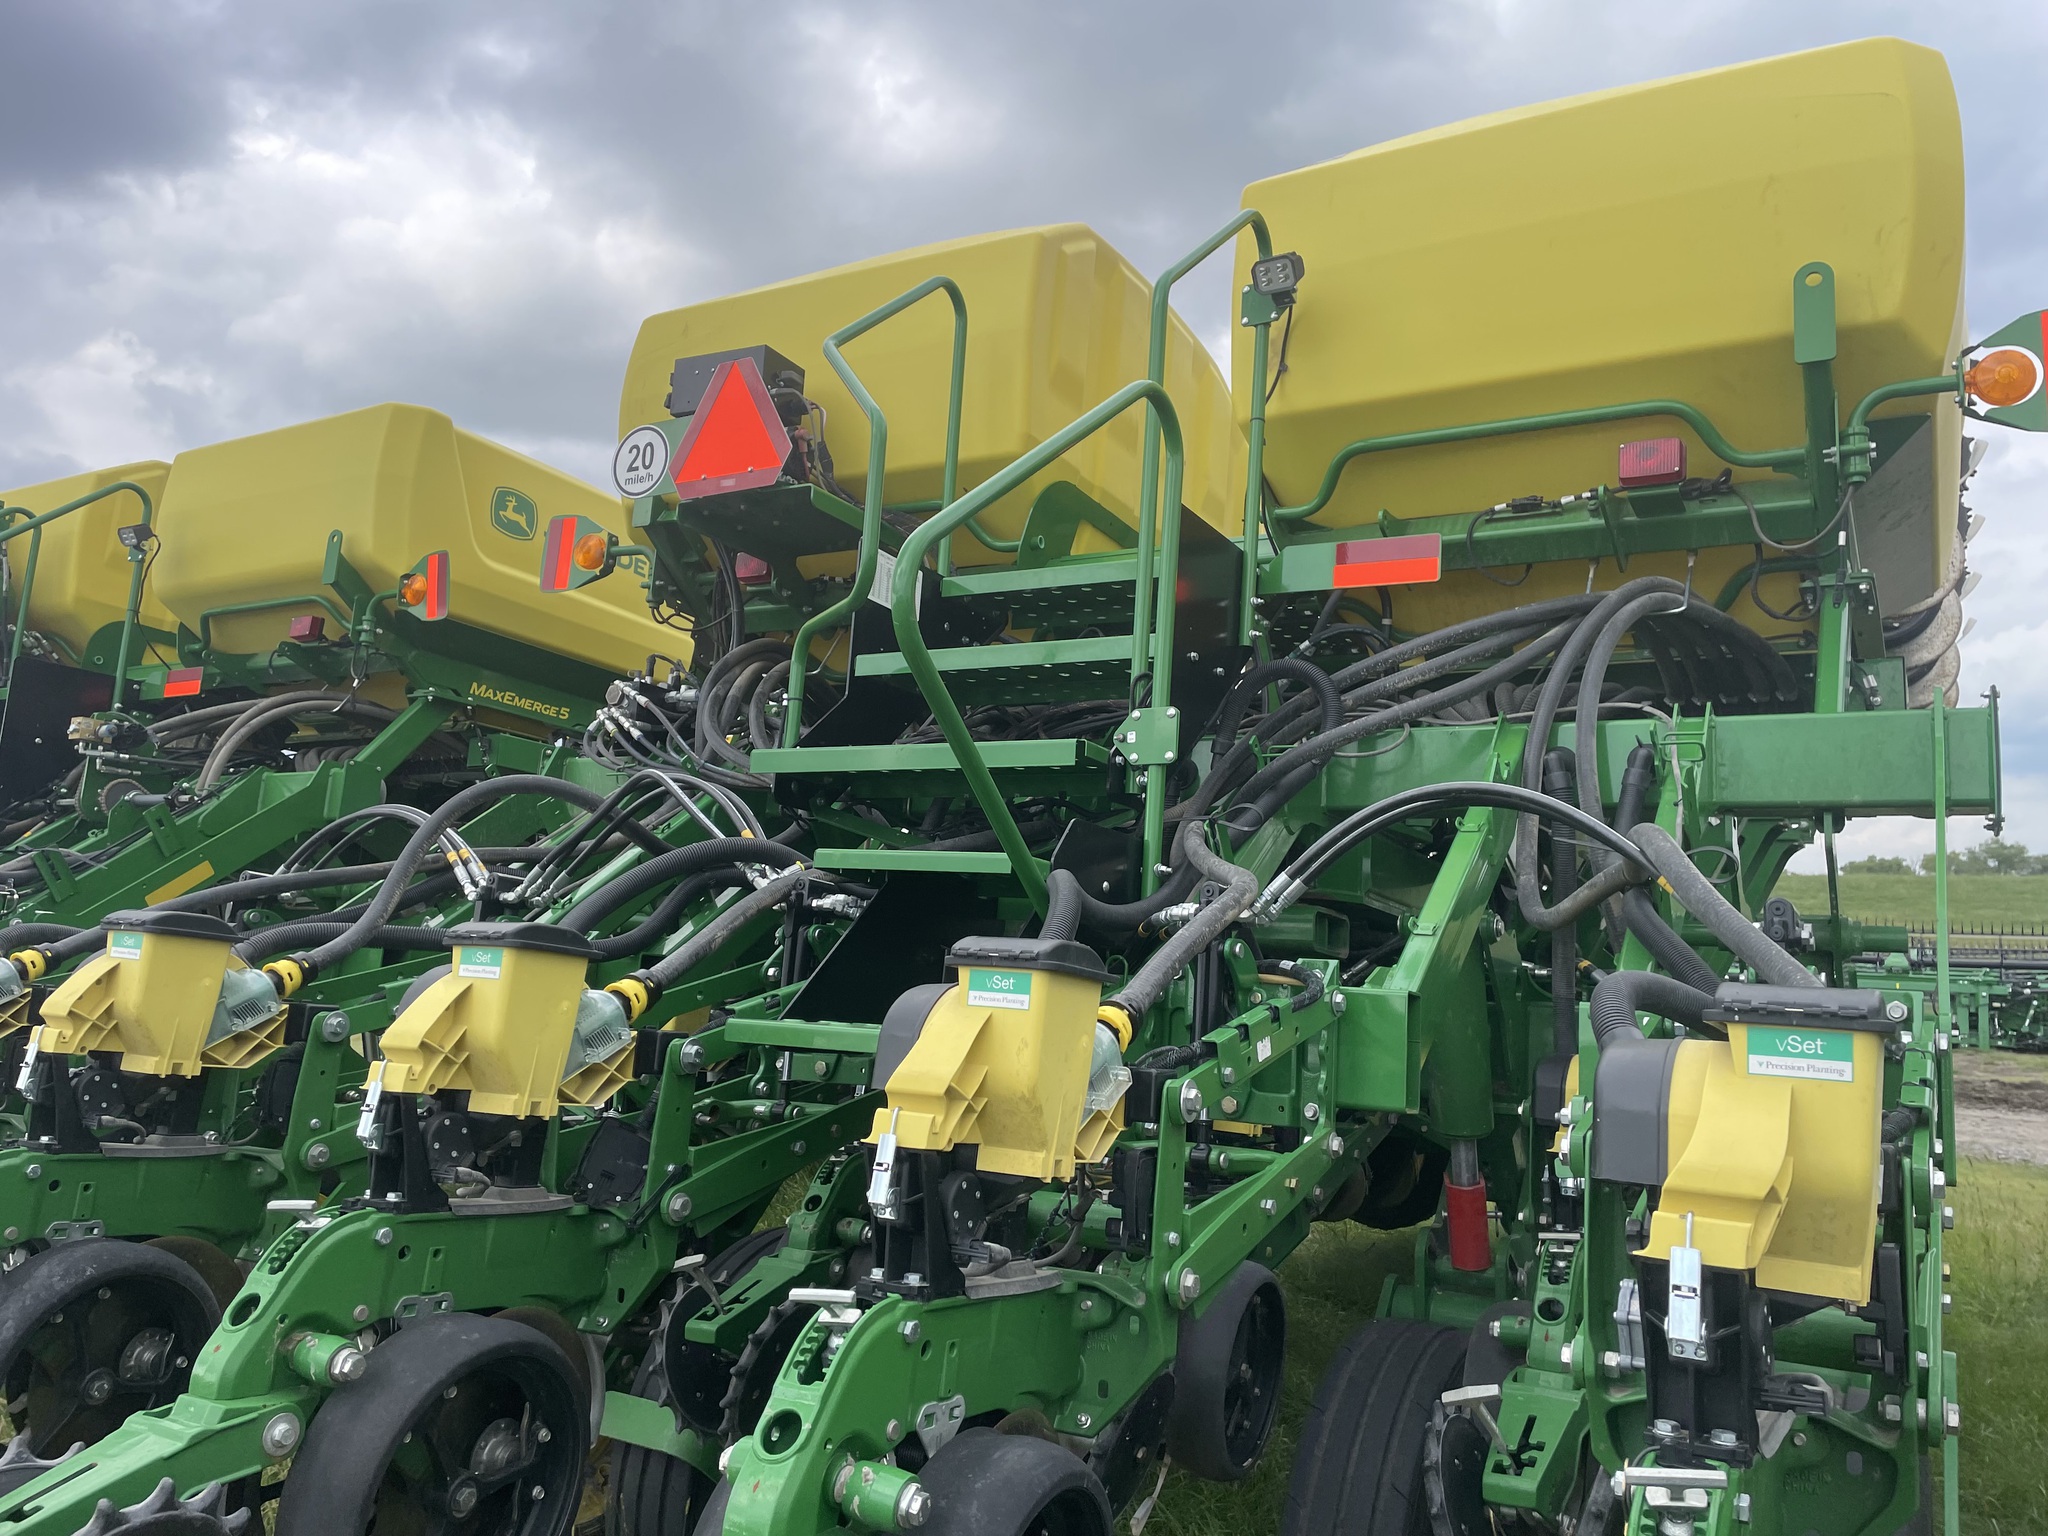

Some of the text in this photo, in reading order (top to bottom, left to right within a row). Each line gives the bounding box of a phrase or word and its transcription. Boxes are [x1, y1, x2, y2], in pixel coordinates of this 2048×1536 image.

[626, 441, 655, 473] 20
[624, 472, 654, 486] mile/h
[985, 975, 1014, 990] vSet
[1775, 1035, 1824, 1055] vSet
[1766, 1060, 1844, 1078] Precision Planting
